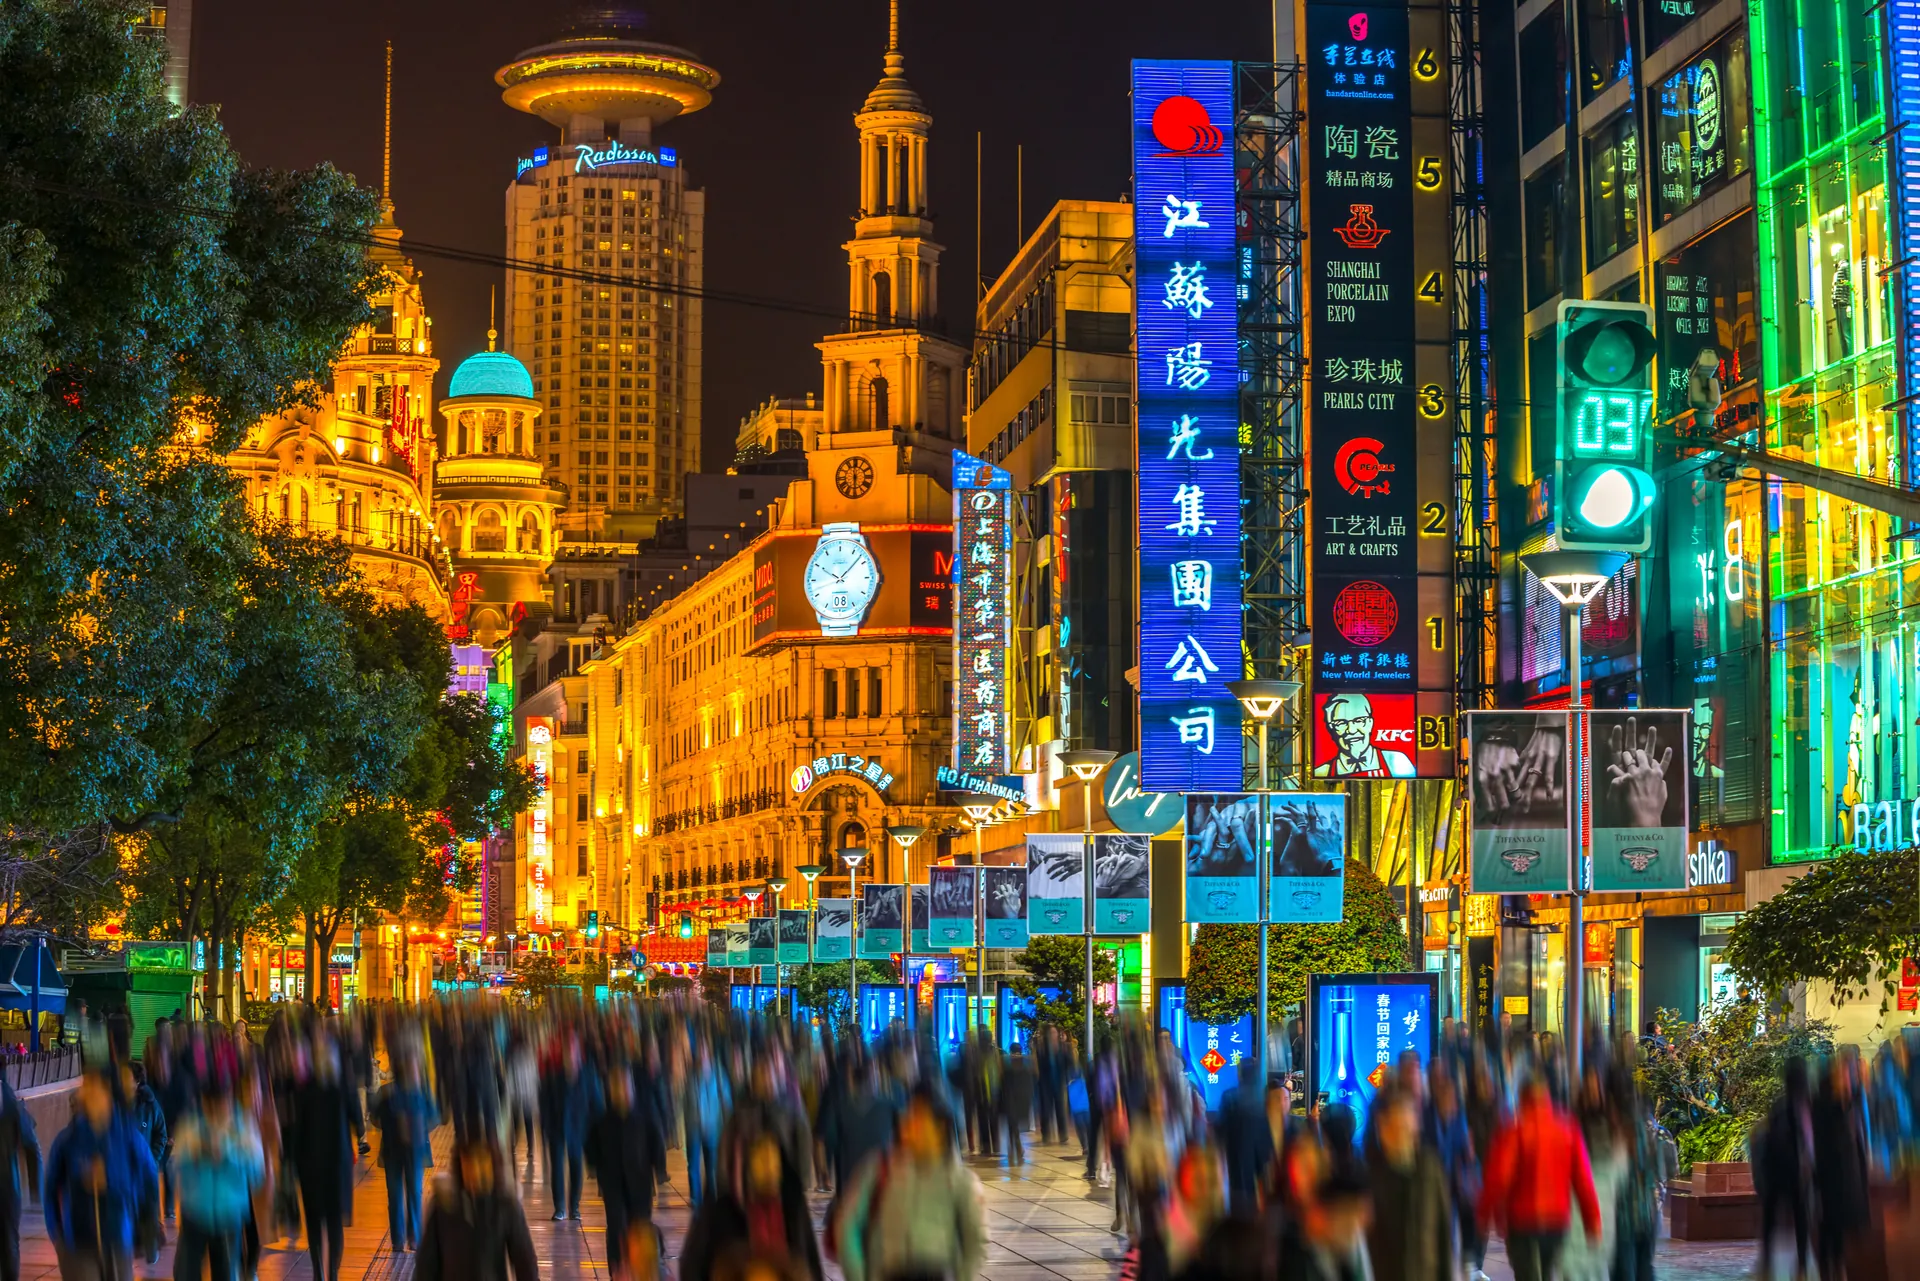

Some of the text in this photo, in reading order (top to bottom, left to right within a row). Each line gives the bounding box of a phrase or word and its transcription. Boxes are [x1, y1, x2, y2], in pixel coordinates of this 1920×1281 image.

[1334, 73, 1385, 85] 体验店
[1415, 48, 1439, 81] 6
[1326, 90, 1394, 99] handartonline.com
[574, 140, 658, 173] Radisson
[1325, 124, 1398, 160] 陶瓷
[1325, 170, 1394, 189] 精品商场
[1416, 157, 1441, 190] 5
[1327, 261, 1380, 280] SHANGHAI
[1327, 283, 1389, 301] PORCELAIN
[1418, 271, 1444, 303] 4
[1327, 305, 1355, 322] EXPO
[1325, 357, 1403, 385] 珍珠城
[1324, 392, 1395, 411] PEARLS CITY
[1420, 385, 1446, 419] 3
[1577, 396, 1633, 450] 03
[1161, 194, 1219, 754] 江蘇陽光集團公司
[1325, 515, 1406, 537] 工艺礼品
[1421, 502, 1447, 538] 2
[1326, 543, 1399, 557] ART & CRAFTS
[919, 582, 946, 590] SWISS
[834, 596, 847, 607] 08
[1425, 616, 1445, 651] 1
[1321, 652, 1410, 668] 新世界銀樓
[1322, 671, 1411, 680] New World Jewelers
[1375, 729, 1414, 742] KFC
[1417, 715, 1452, 750] B1
[812, 753, 884, 783] 锦江之星
[936, 766, 1026, 802] NO.1 PHARMACY
[1688, 840, 1726, 887] shka
[1204, 1025, 1222, 1084] 家的礼物
